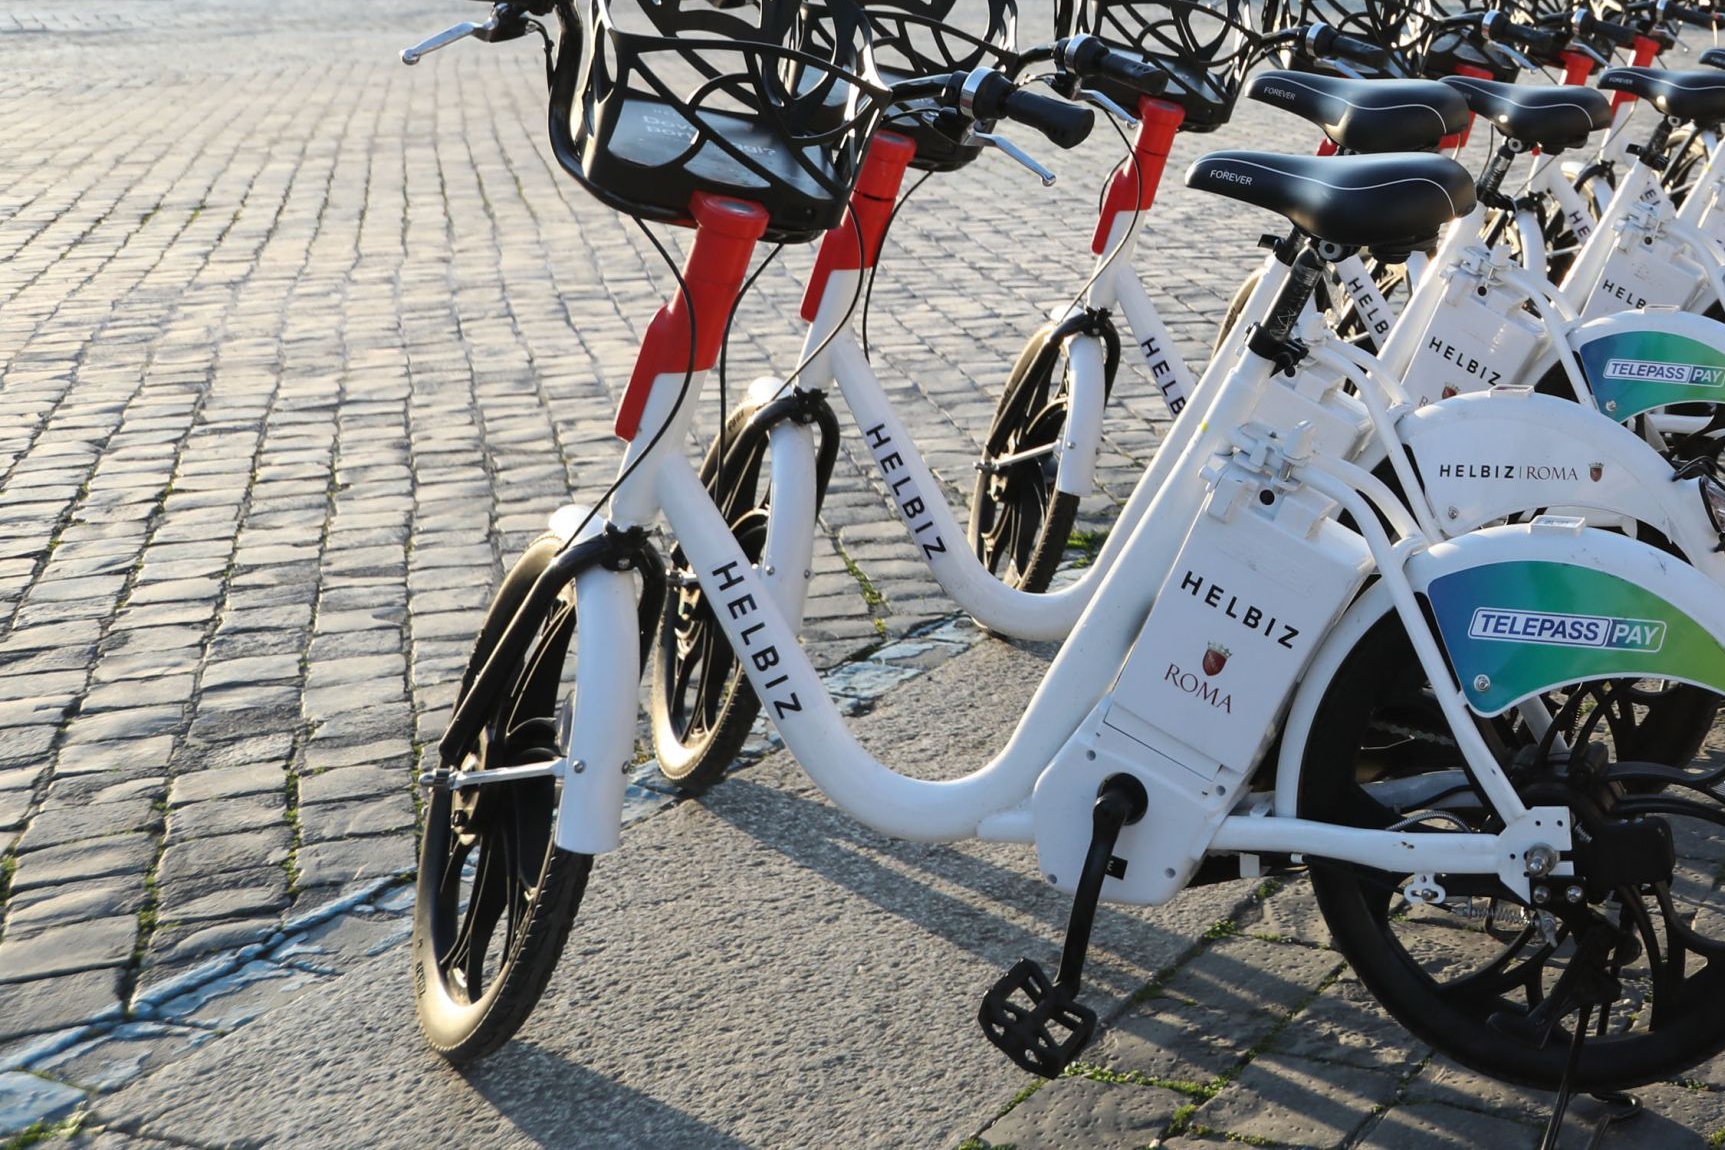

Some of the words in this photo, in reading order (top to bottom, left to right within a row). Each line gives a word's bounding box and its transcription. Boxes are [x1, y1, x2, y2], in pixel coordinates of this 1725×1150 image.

[1264, 86, 1296, 100] FOREVER
[1210, 169, 1253, 186] FOREVER
[1348, 277, 1389, 336] HELB
[1602, 279, 1646, 310] HELB
[1141, 336, 1186, 415] HELB
[1429, 336, 1501, 386] HELBIZ
[1611, 363, 1685, 380] TELEPASS
[1692, 369, 1722, 384] PAY
[866, 424, 947, 561] HELBIZ
[1439, 464, 1515, 479] HELBIZ
[1526, 466, 1578, 481] ROMA
[1181, 570, 1299, 649] HELBIZ
[1481, 613, 1600, 641] TELEPASS
[1612, 624, 1659, 646] PAY
[712, 561, 803, 720] HELBIZ
[1164, 664, 1232, 714] ROMA
